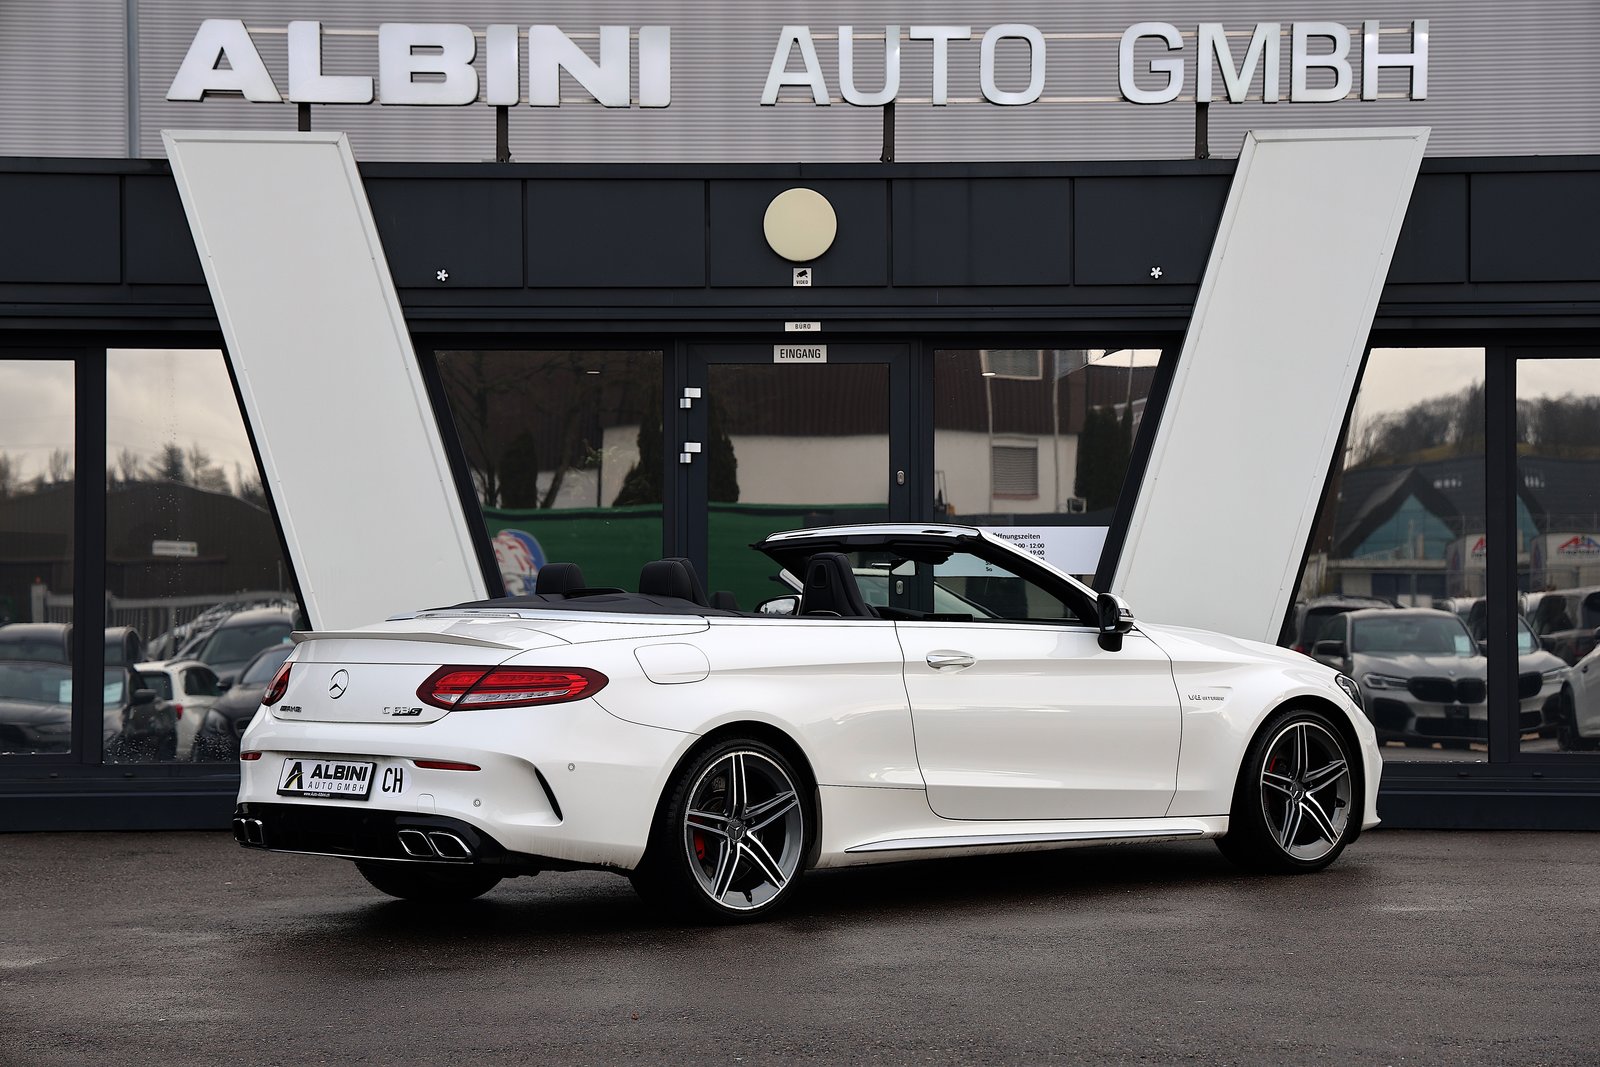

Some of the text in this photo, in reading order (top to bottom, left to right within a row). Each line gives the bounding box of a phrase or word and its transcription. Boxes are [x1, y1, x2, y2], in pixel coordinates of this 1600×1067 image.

[166, 18, 1429, 108] ALBINI AUTO GMBH
[780, 348, 821, 359] EINGANG
[310, 763, 369, 782] ALBINI
[382, 767, 404, 793] CH
[308, 781, 365, 792] AUTO GMBH
